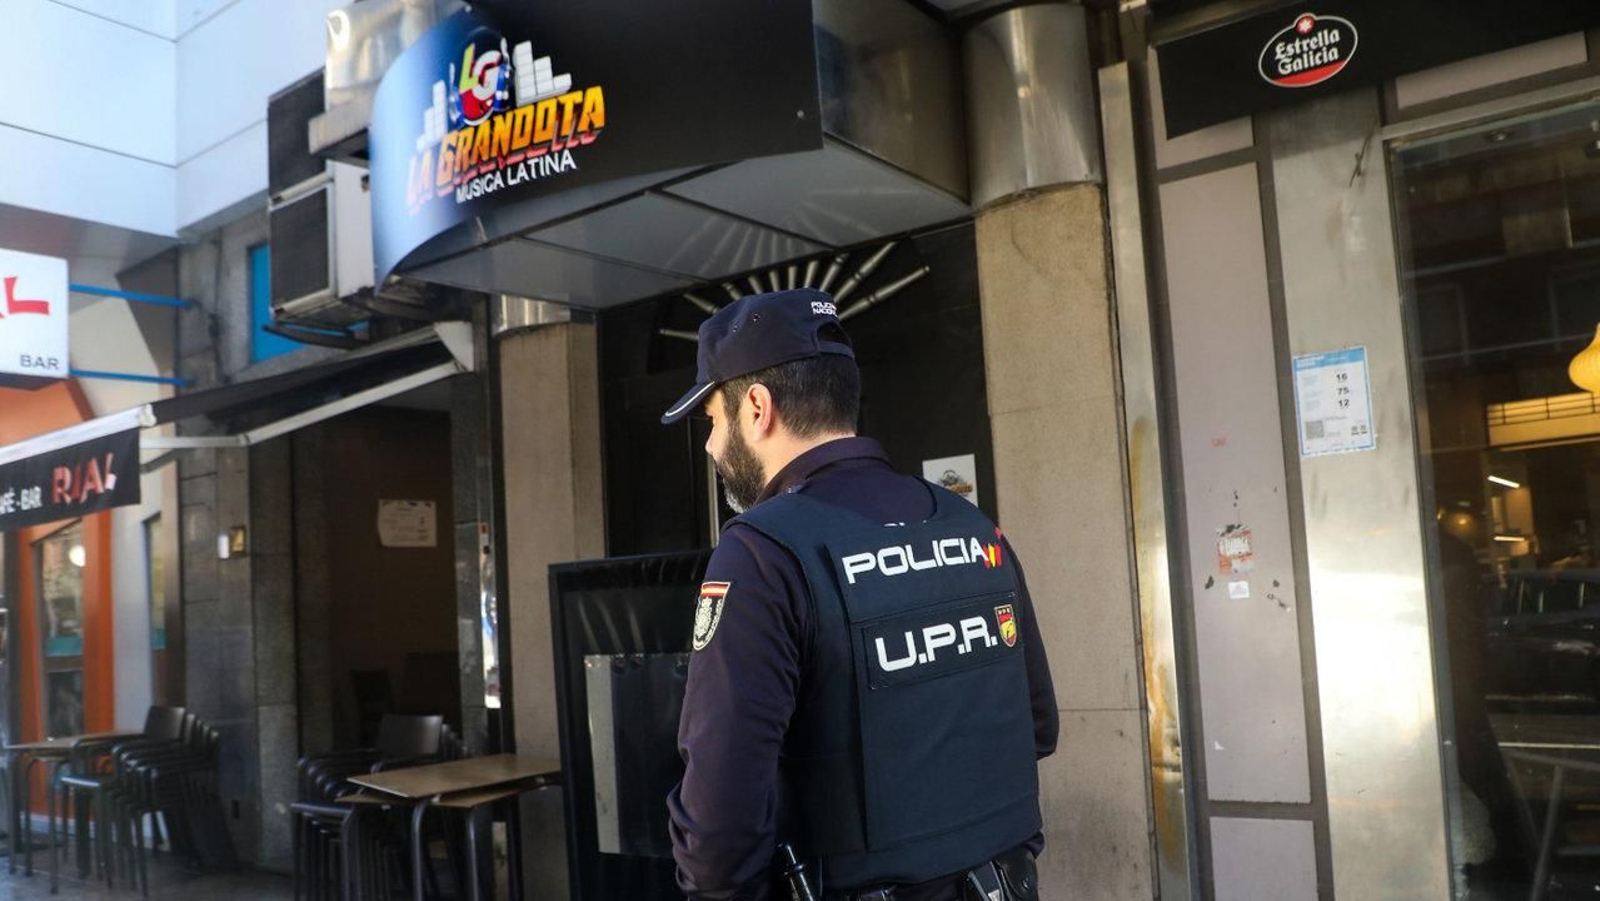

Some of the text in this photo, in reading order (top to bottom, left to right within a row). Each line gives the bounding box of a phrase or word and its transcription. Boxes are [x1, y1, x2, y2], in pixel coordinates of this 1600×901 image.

[1275, 29, 1341, 60] Estrella
[1278, 46, 1340, 75] Galicia
[405, 85, 606, 214] LA GRANDOTA
[456, 149, 577, 204] MUSICA LATINA
[0, 276, 50, 316] L
[20, 354, 60, 371] BAR
[842, 537, 989, 584] POLICIA
